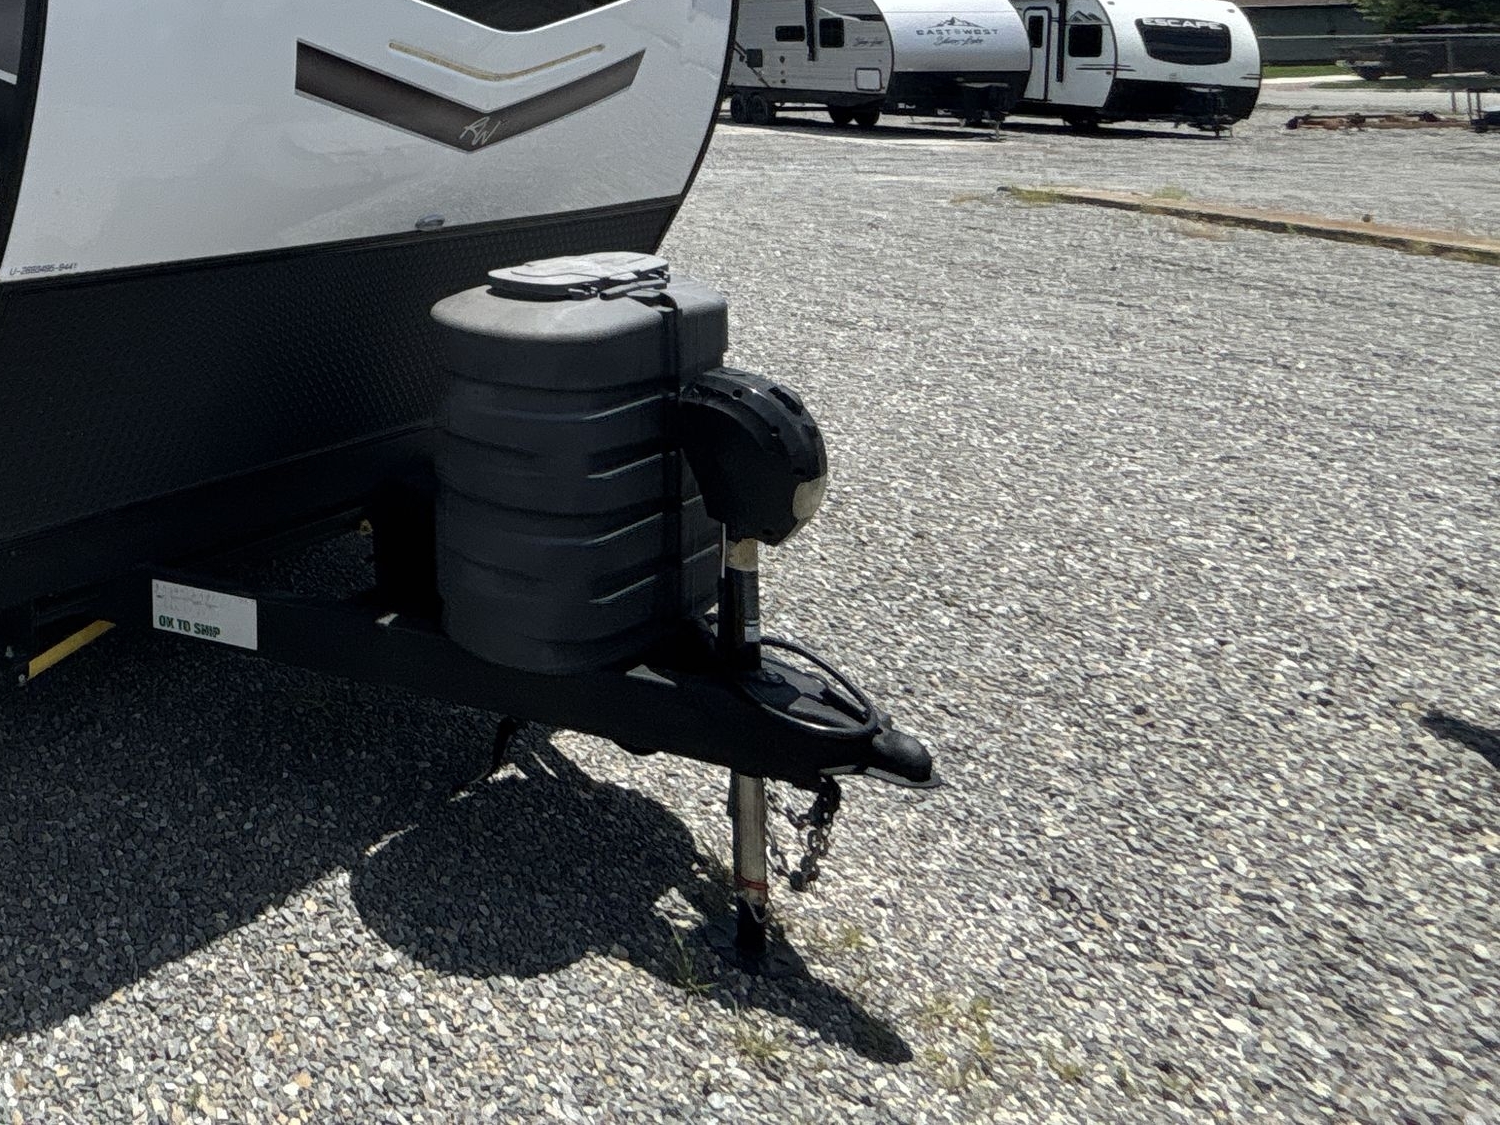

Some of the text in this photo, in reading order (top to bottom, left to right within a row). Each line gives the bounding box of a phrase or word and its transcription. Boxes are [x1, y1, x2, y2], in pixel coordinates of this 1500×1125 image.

[1142, 18, 1223, 31] ESCAPE
[159, 614, 221, 638] OK TO SHIP
